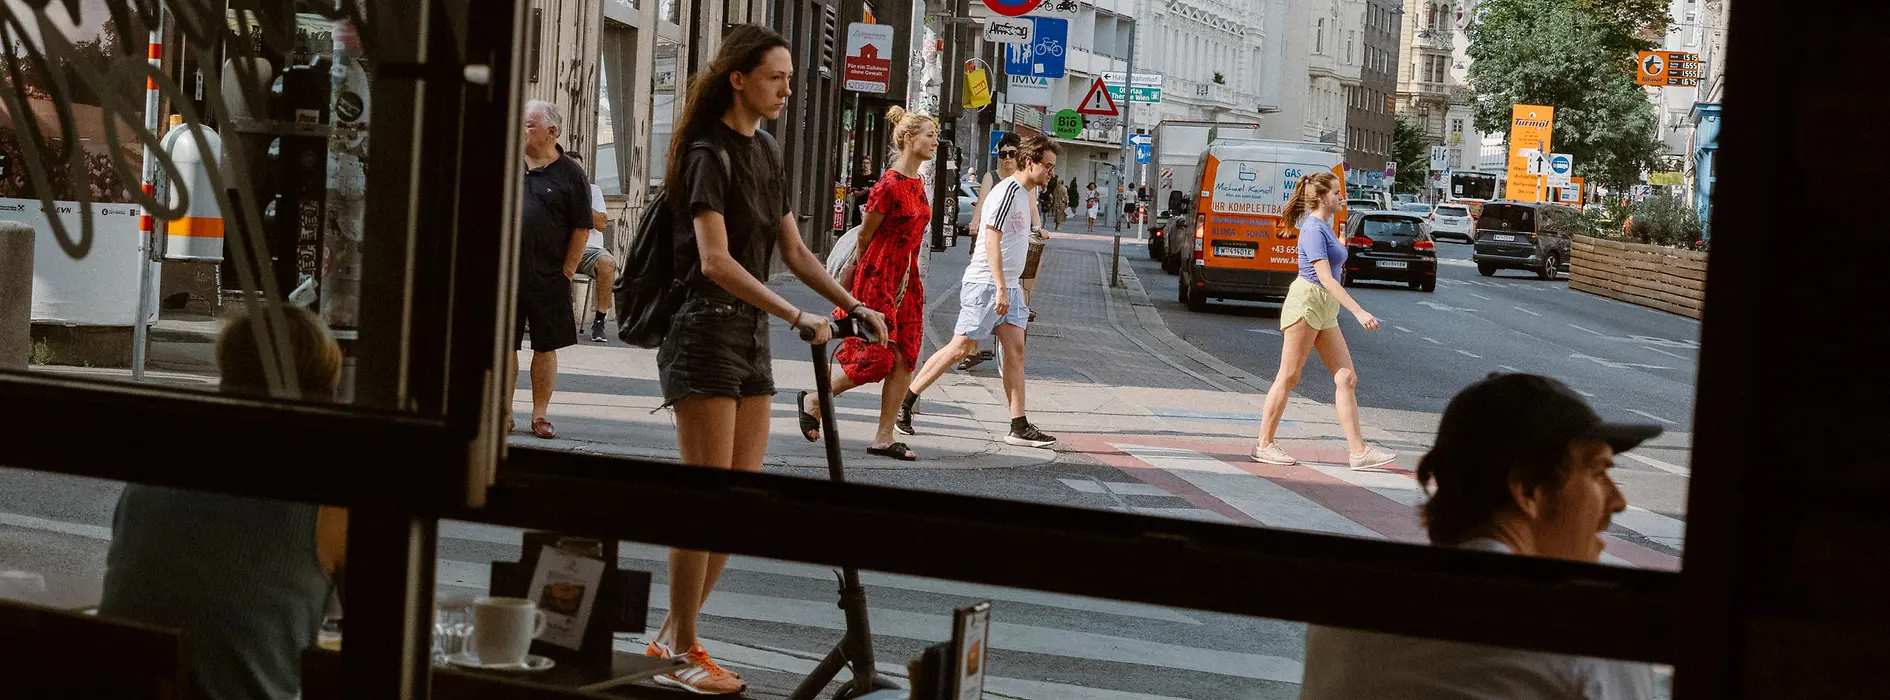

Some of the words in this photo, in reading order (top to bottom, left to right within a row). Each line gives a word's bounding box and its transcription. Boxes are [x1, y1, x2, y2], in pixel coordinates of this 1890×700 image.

[989, 22, 1028, 39] Anfg
[1113, 74, 1158, 82] Haubahnhof
[855, 82, 884, 91] 057722
[1059, 116, 1076, 127] Bio
[1515, 118, 1550, 127] Turmöl
[1284, 168, 1301, 178] GAS
[1215, 182, 1245, 192] Michael
[1213, 202, 1225, 211] IHR
[1228, 203, 1282, 214] KOMPLETTBA
